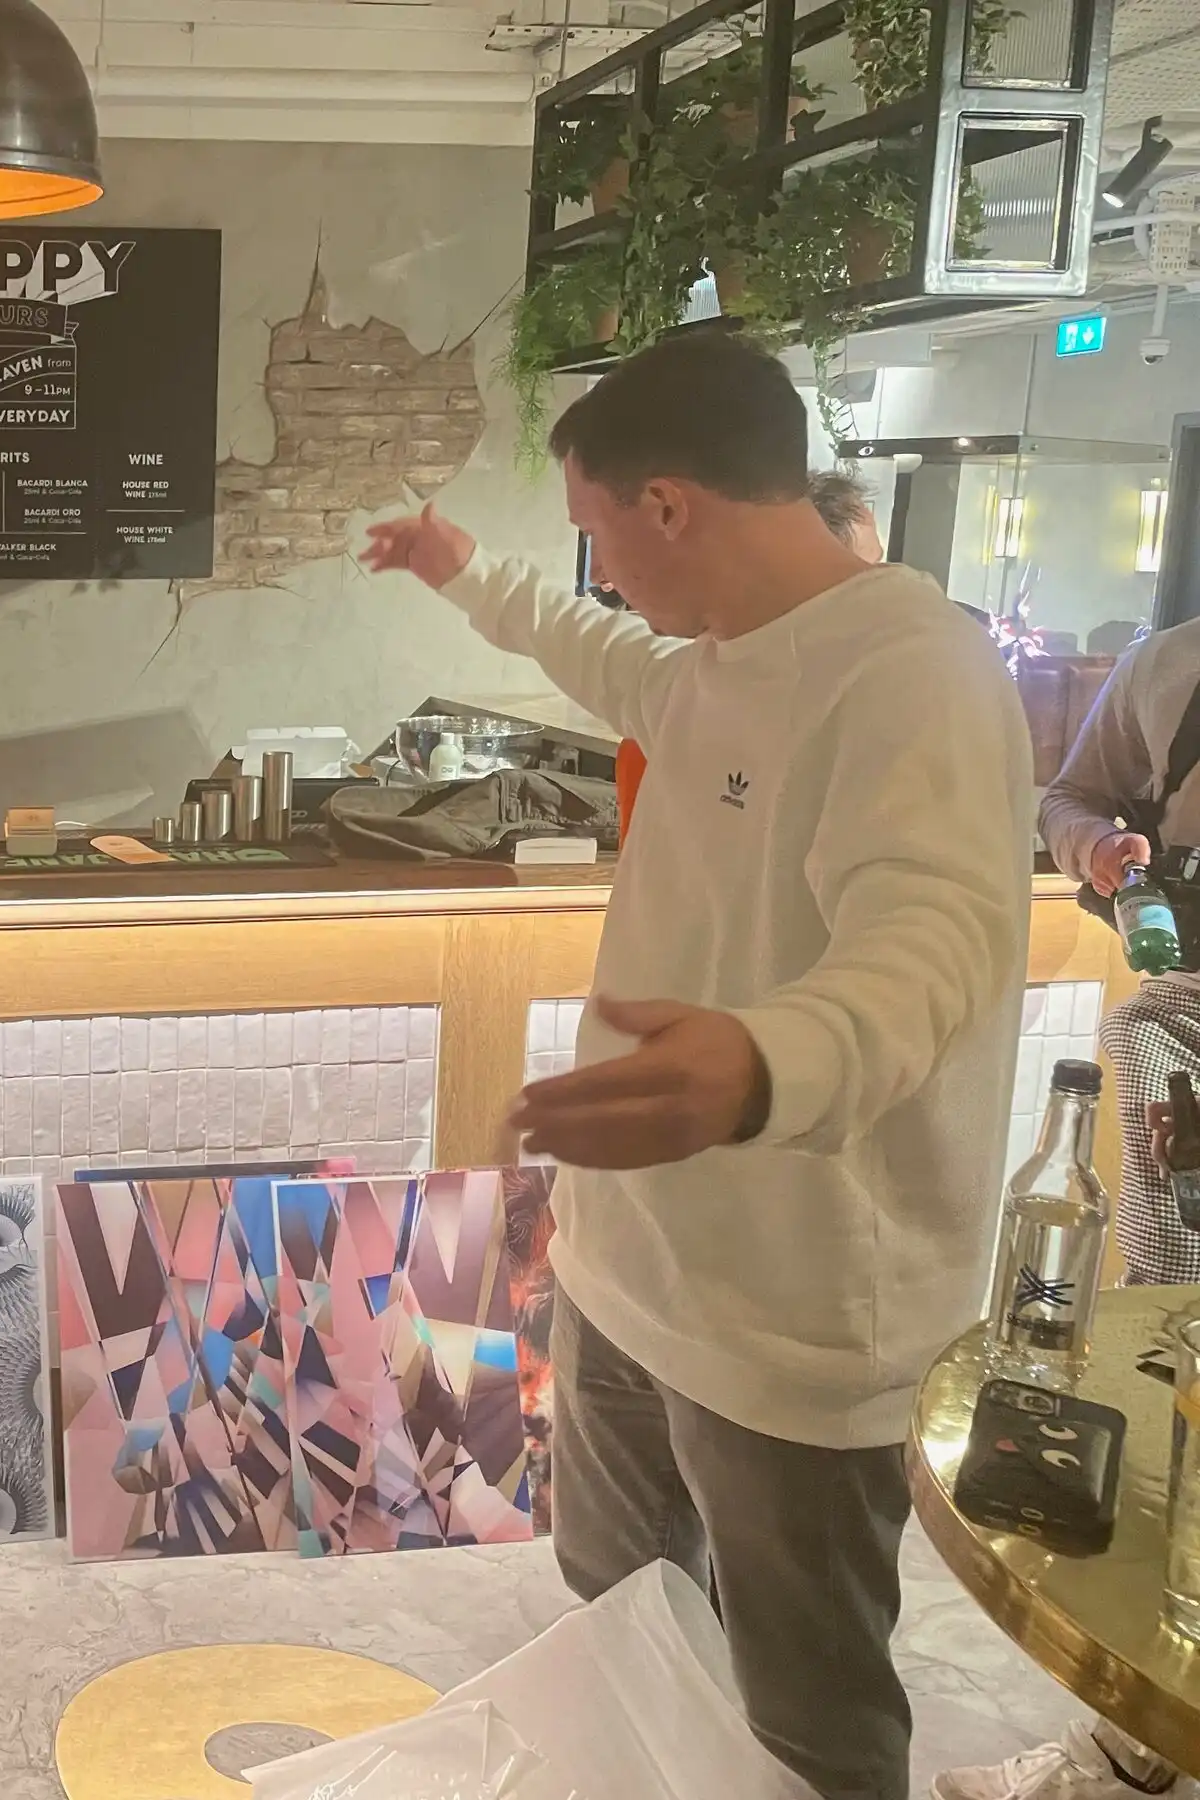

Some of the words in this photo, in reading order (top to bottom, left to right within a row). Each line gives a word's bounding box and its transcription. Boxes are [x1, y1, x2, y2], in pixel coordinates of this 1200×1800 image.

[47, 358, 72, 368] from
[128, 453, 164, 466] WINE
[16, 479, 54, 488] BACARDI
[55, 479, 89, 488] BLANCA
[122, 481, 151, 490] HOUSE
[153, 481, 170, 490] RED
[125, 489, 147, 499] WINE
[23, 508, 60, 517] BACARDI
[62, 508, 82, 517] ORO
[116, 525, 145, 535] HOUSE
[147, 526, 174, 535] WHITE
[123, 534, 145, 544] WINE
[29, 543, 57, 552] BLACK
